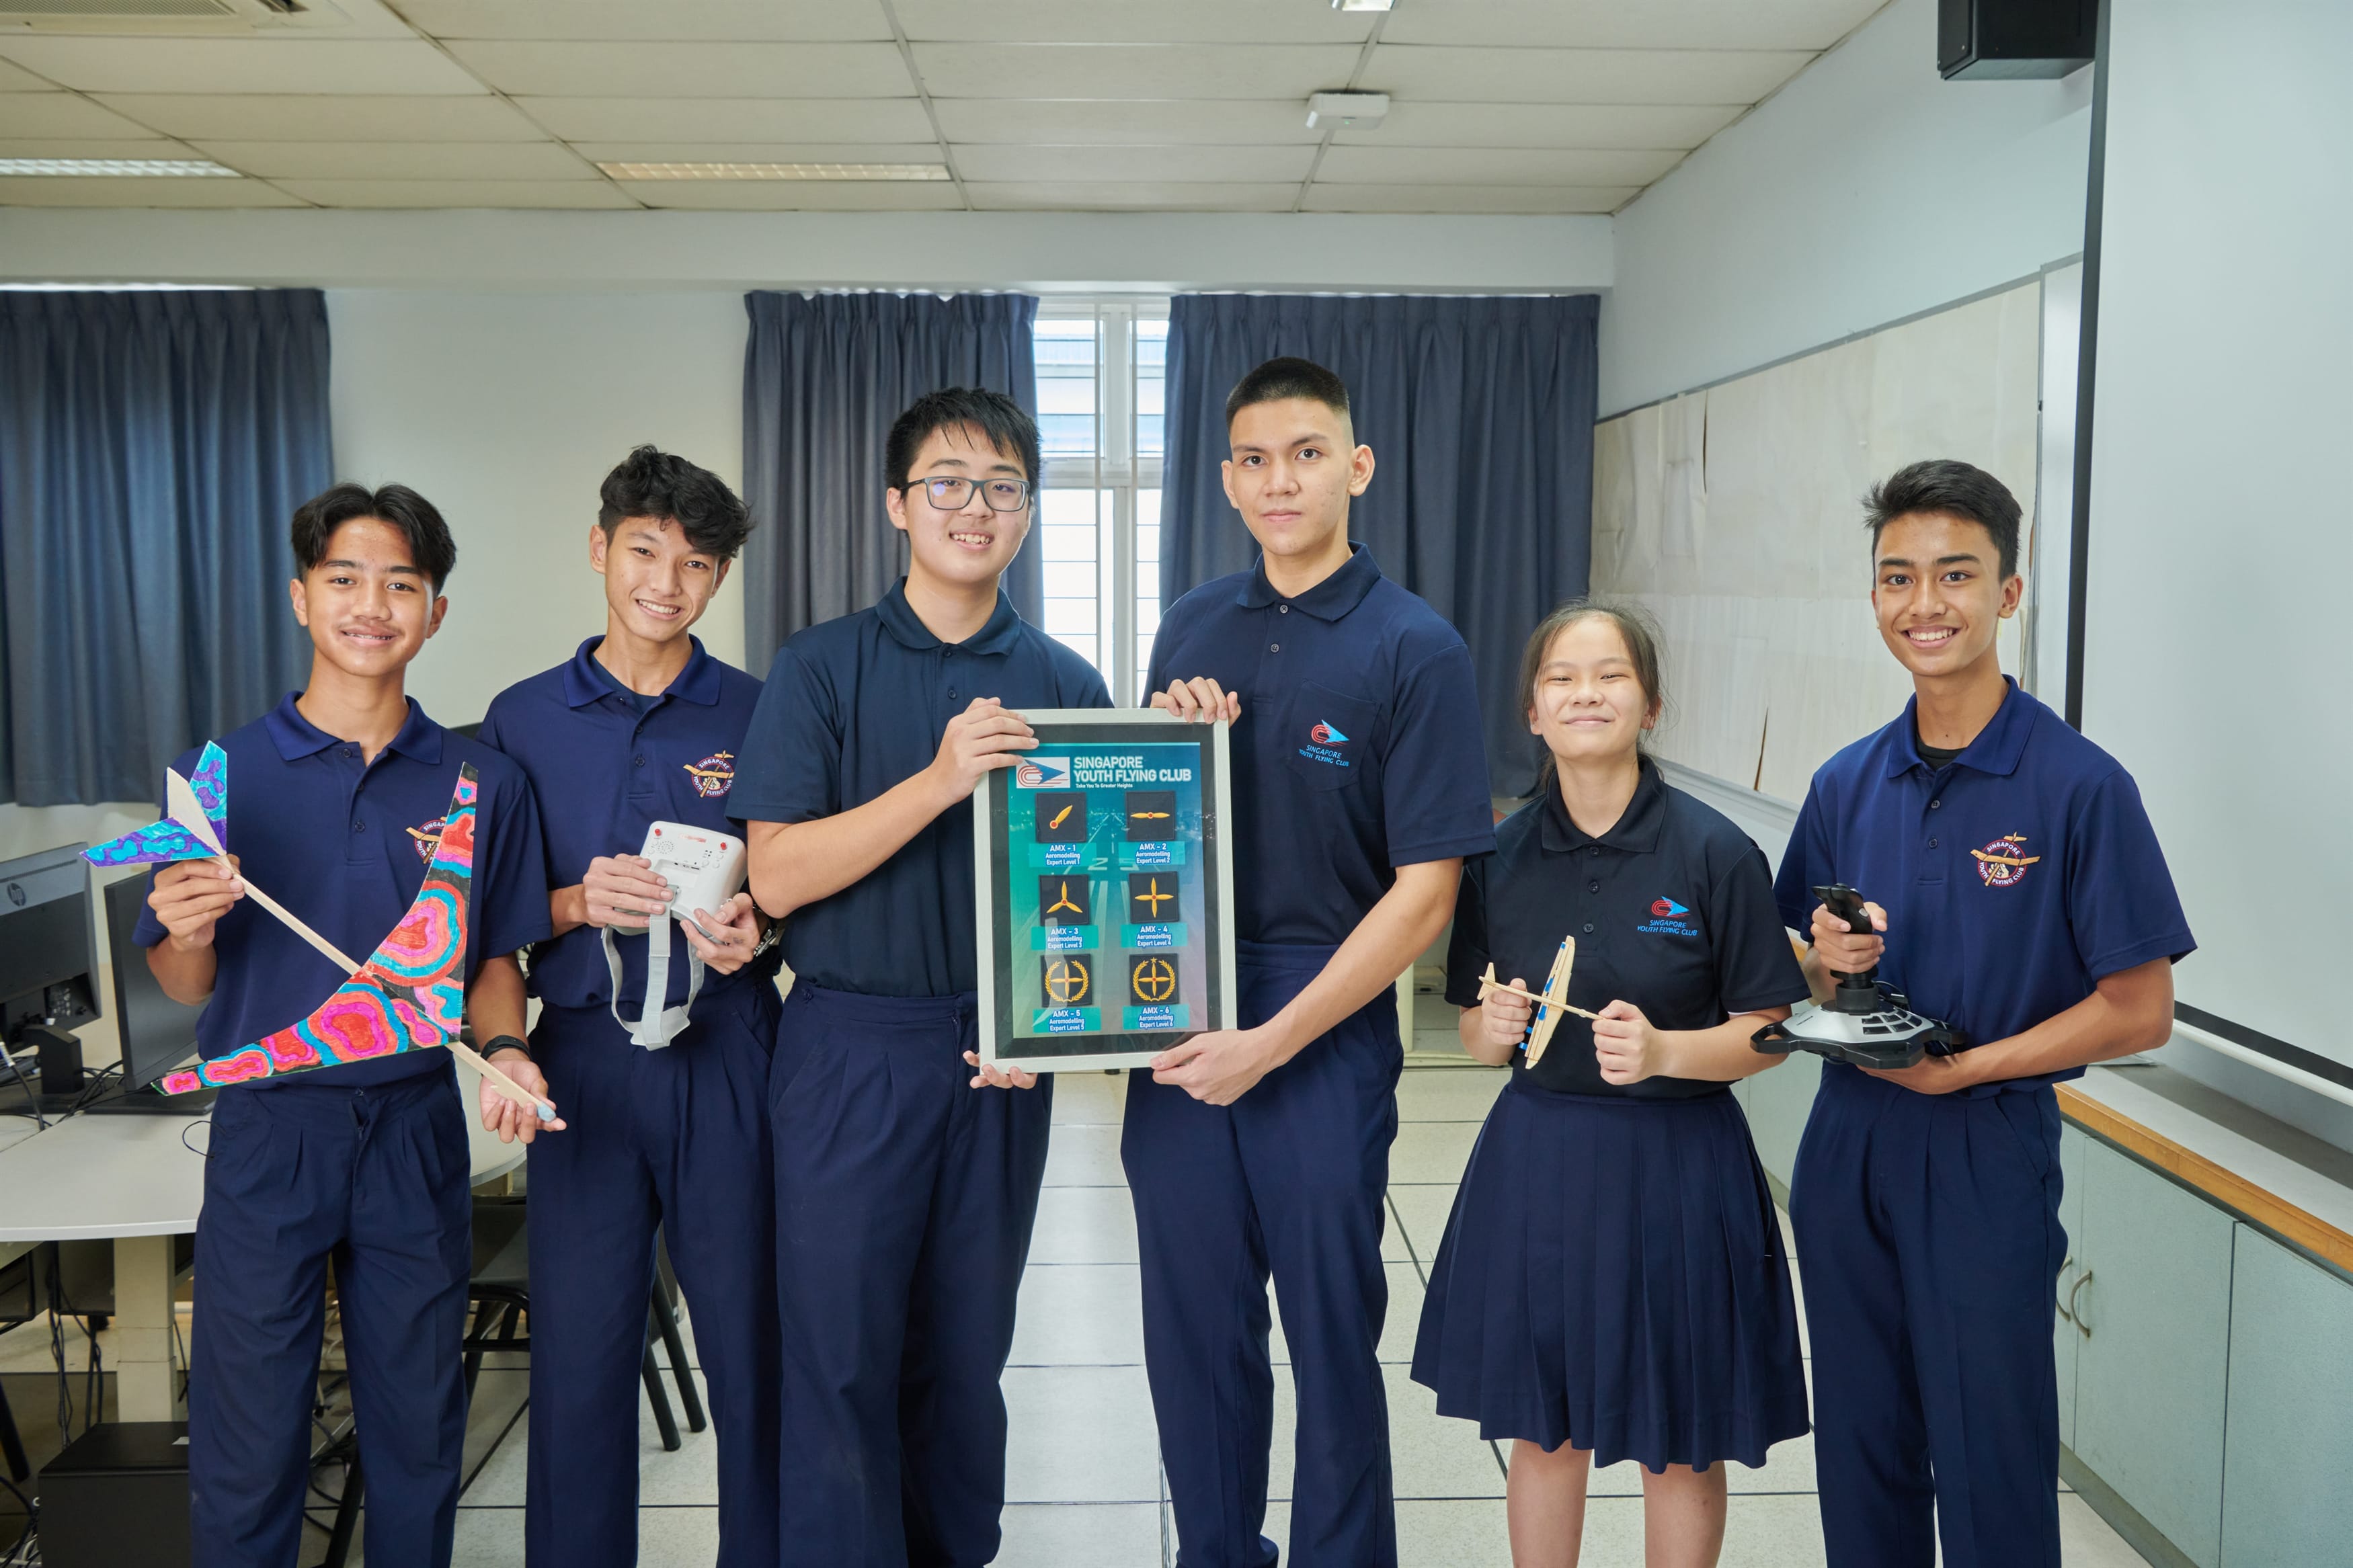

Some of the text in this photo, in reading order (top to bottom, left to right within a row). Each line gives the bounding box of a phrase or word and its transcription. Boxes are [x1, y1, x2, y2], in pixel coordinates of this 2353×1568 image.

[1299, 748, 1313, 759] YOUTH
[1315, 755, 1333, 764] FLYING
[1306, 745, 1342, 759] SINGAPORE
[699, 758, 729, 769] SINGAPORE
[1074, 756, 1143, 769] SINGAPORE
[1073, 768, 1192, 782] YOUTH FLYING CLUB
[694, 776, 703, 791] YOUTH
[723, 780, 732, 791] CLUB
[424, 822, 445, 831] SINGAP
[417, 840, 428, 857] YOUTH
[1987, 841, 2021, 856] SINGAPORE
[1979, 862, 1989, 879] YOUTH
[2013, 867, 2024, 880] CLUB
[9, 883, 24, 907] hp
[1650, 919, 1687, 928] SINGAPORE
